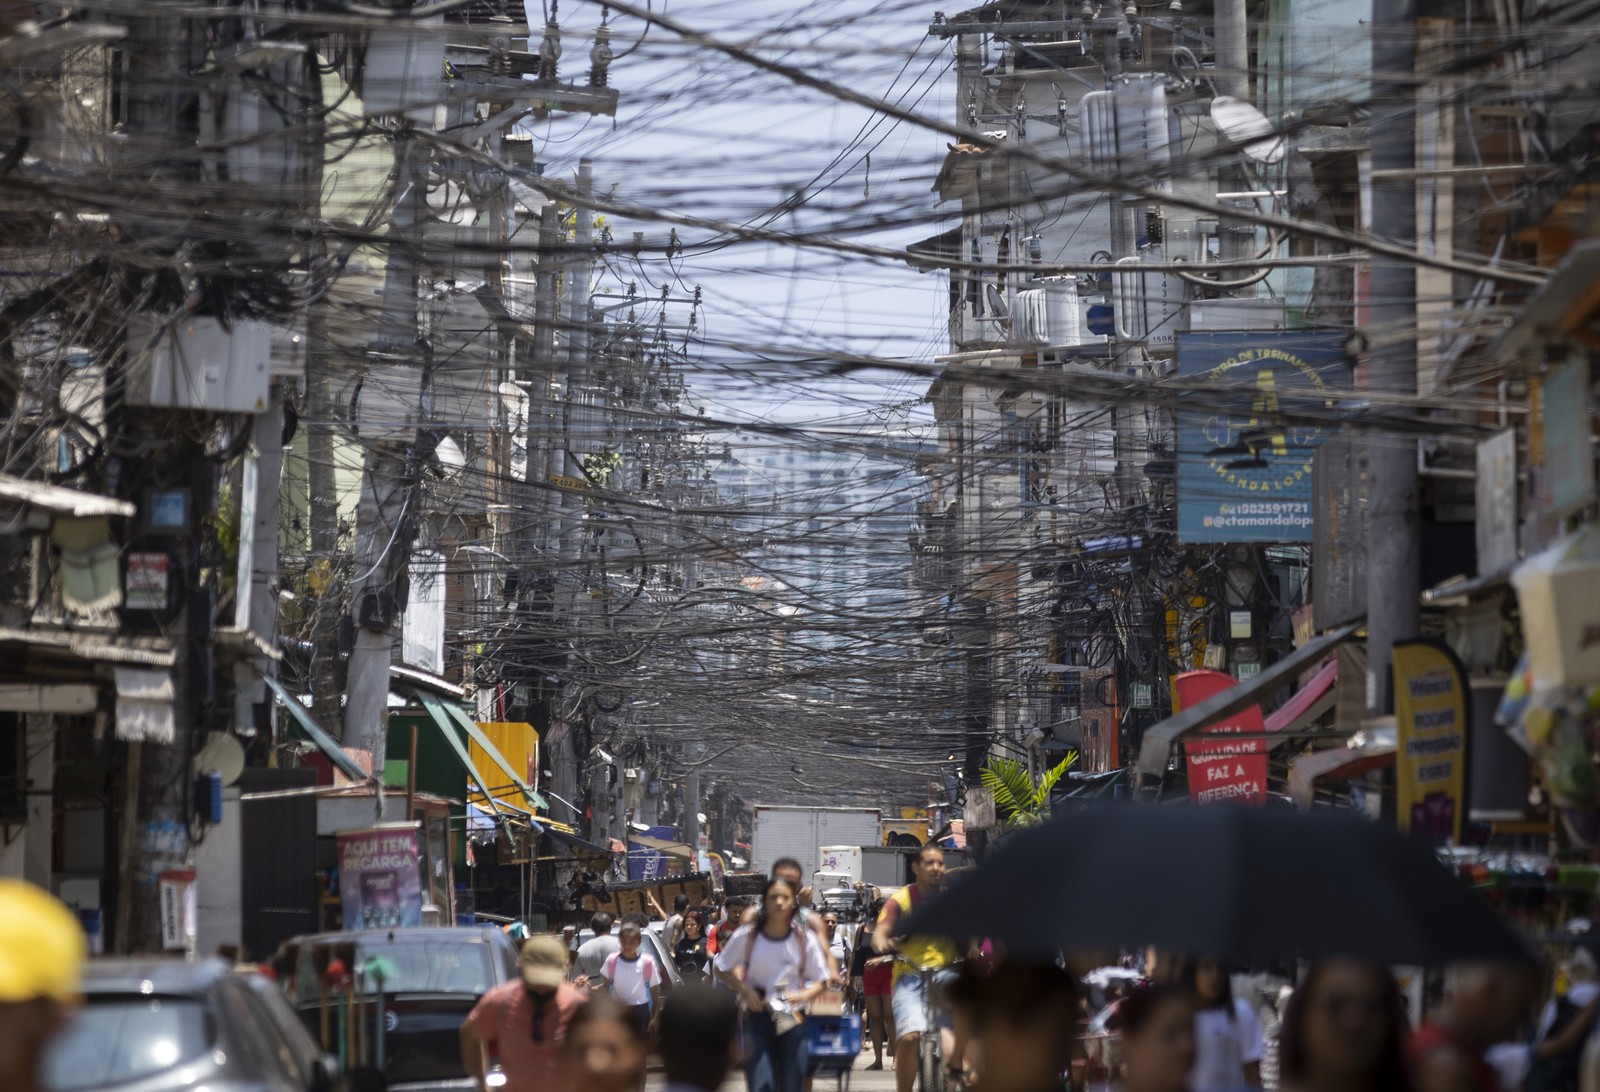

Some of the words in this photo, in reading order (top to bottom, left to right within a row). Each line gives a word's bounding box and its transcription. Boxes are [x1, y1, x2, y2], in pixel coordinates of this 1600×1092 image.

[1238, 350, 1254, 361] DE
[1274, 457, 1313, 490] LOPE
[1207, 765, 1230, 781] FAZ
[1235, 763, 1245, 777] A
[1198, 782, 1260, 802] DIFERENÇA
[343, 840, 378, 856] AQUI
[381, 837, 411, 852] TEM
[344, 854, 412, 871] RECARGA
